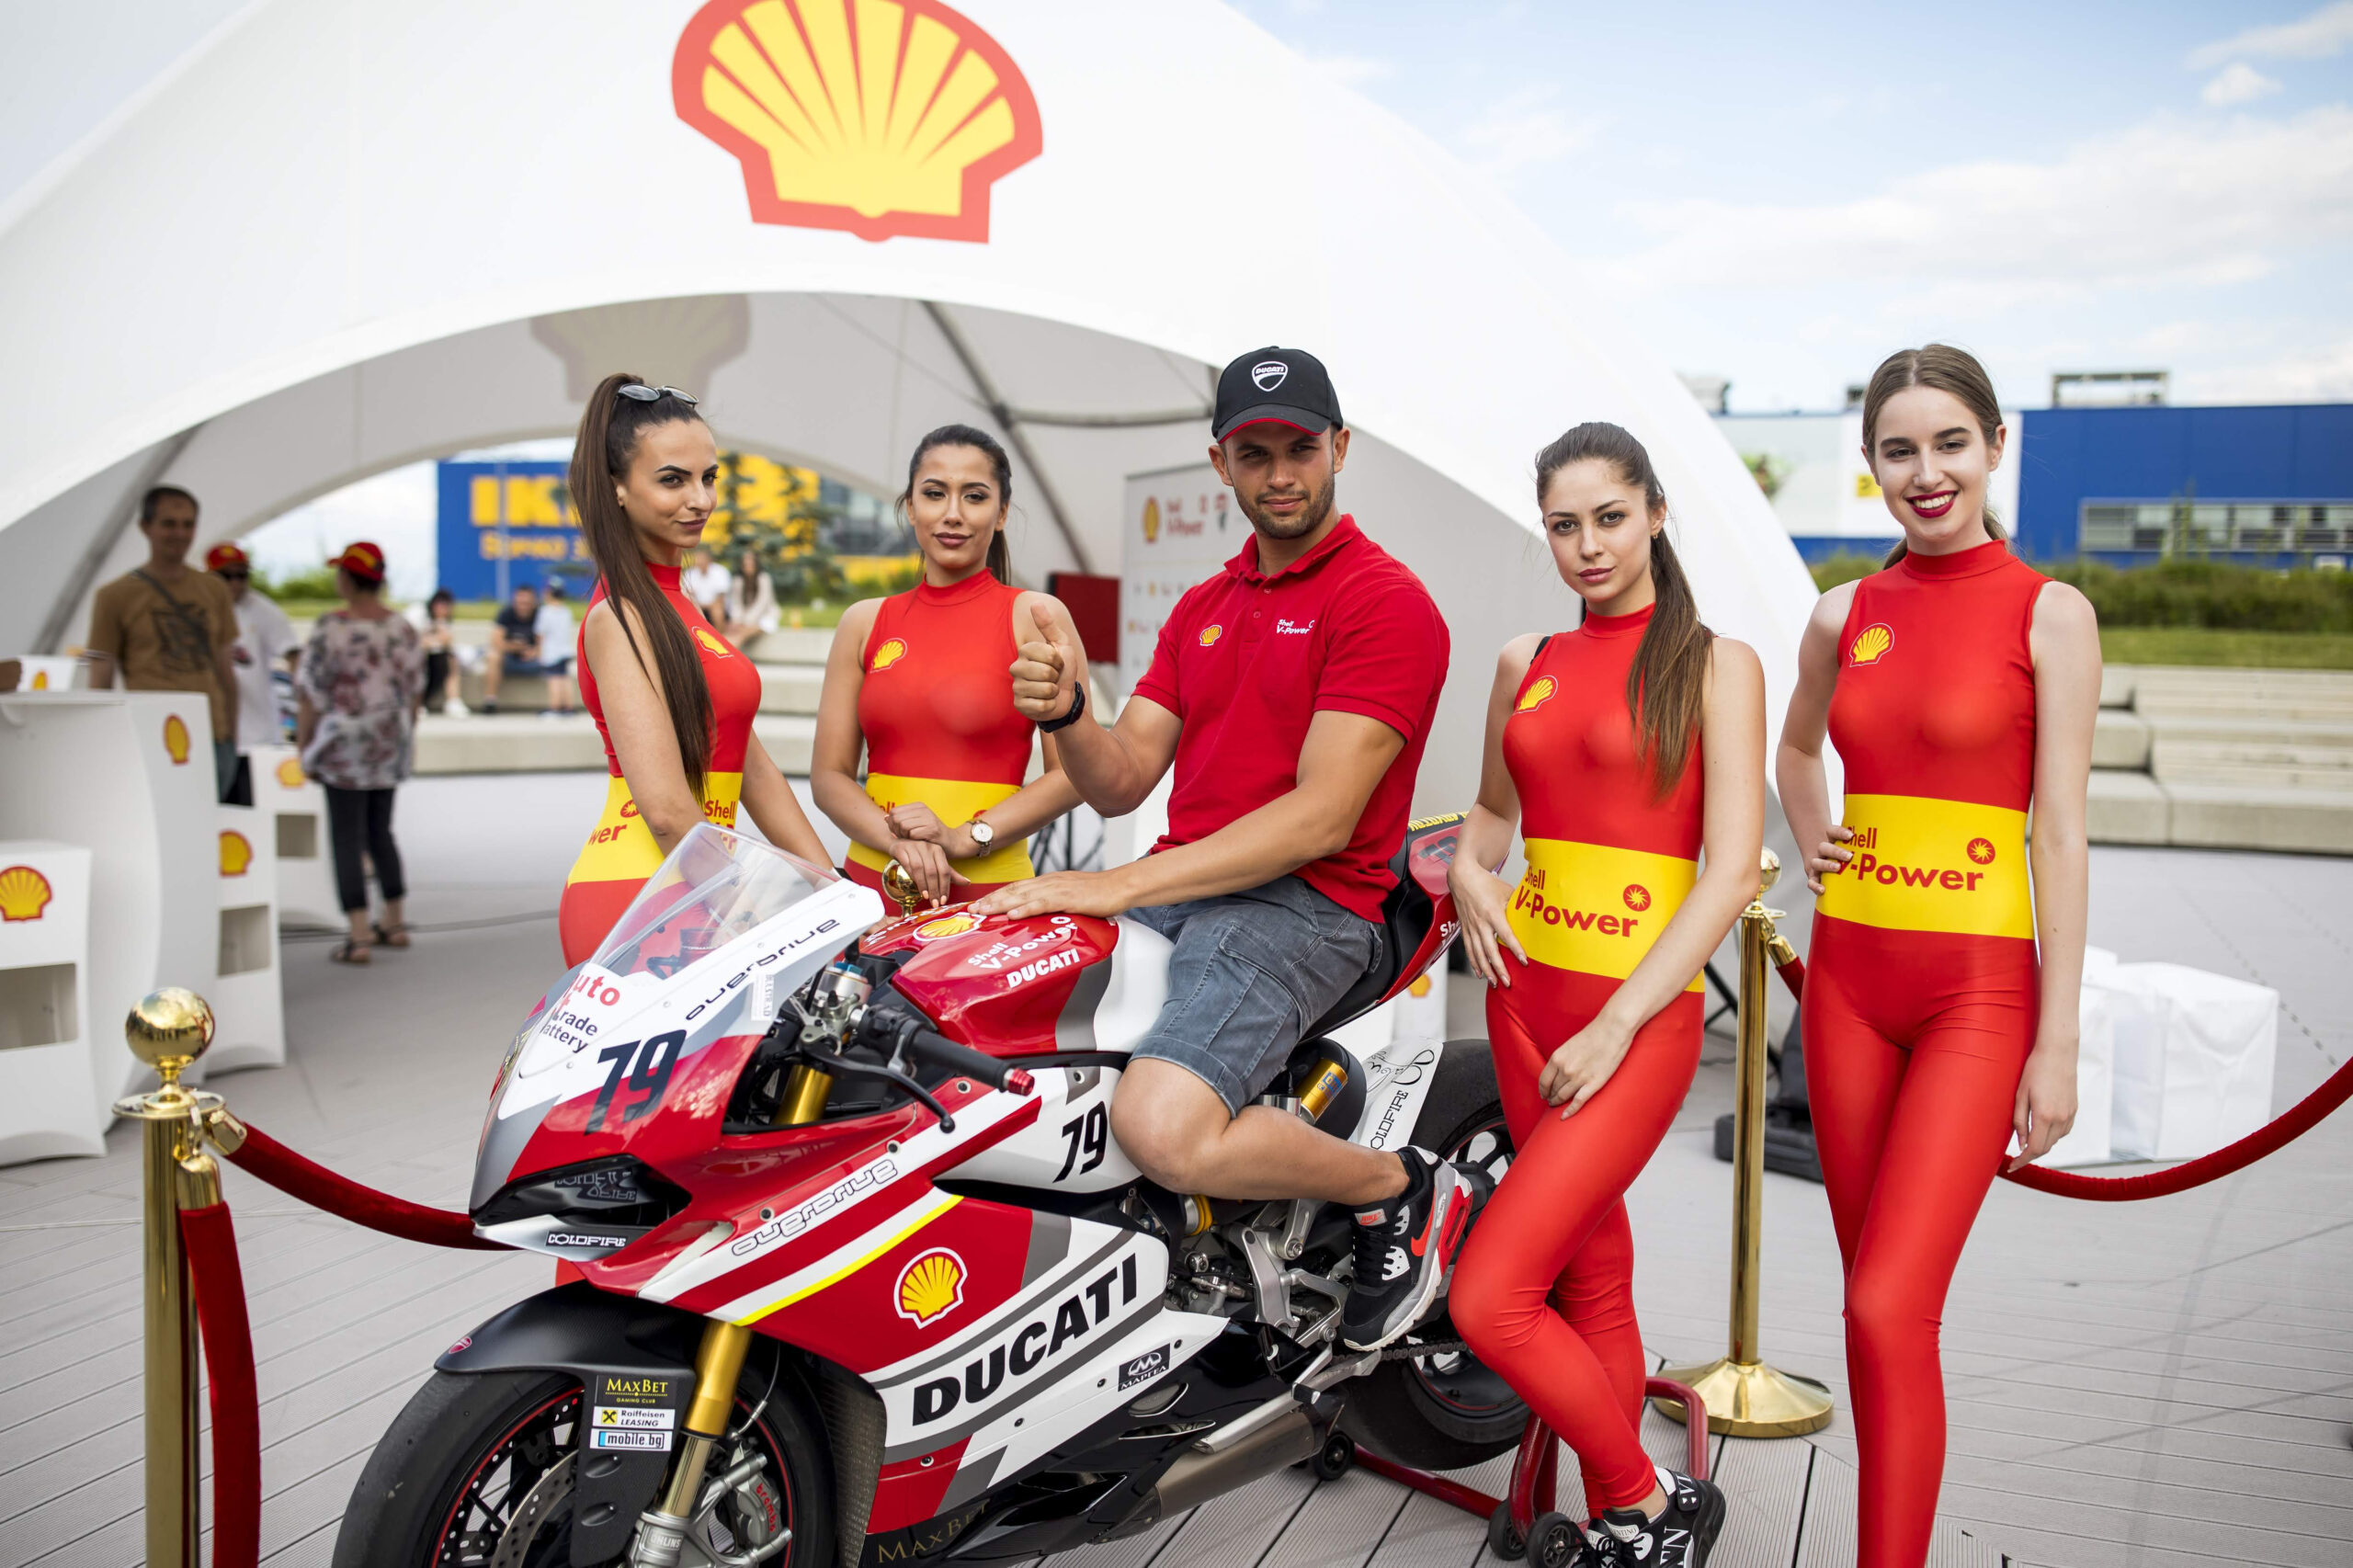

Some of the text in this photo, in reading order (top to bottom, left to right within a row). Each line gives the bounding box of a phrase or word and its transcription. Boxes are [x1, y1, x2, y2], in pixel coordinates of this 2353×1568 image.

[1278, 619, 1294, 627] Shell
[704, 800, 736, 820] Shell
[1525, 865, 1546, 891] Shell
[1515, 885, 1638, 938] V-Power
[968, 942, 1009, 966] Shell
[980, 922, 1079, 971] V-Power
[1006, 949, 1081, 989] DUCATI
[584, 1029, 687, 1136] 79
[1052, 1100, 1108, 1184] 79
[1370, 1090, 1409, 1150] OLDFIRE
[548, 1233, 627, 1247] COLDFIRE
[913, 1253, 1137, 1426] DUCATI
[621, 1410, 665, 1418] Raiffeisen
[756, 1483, 777, 1533] brembo
